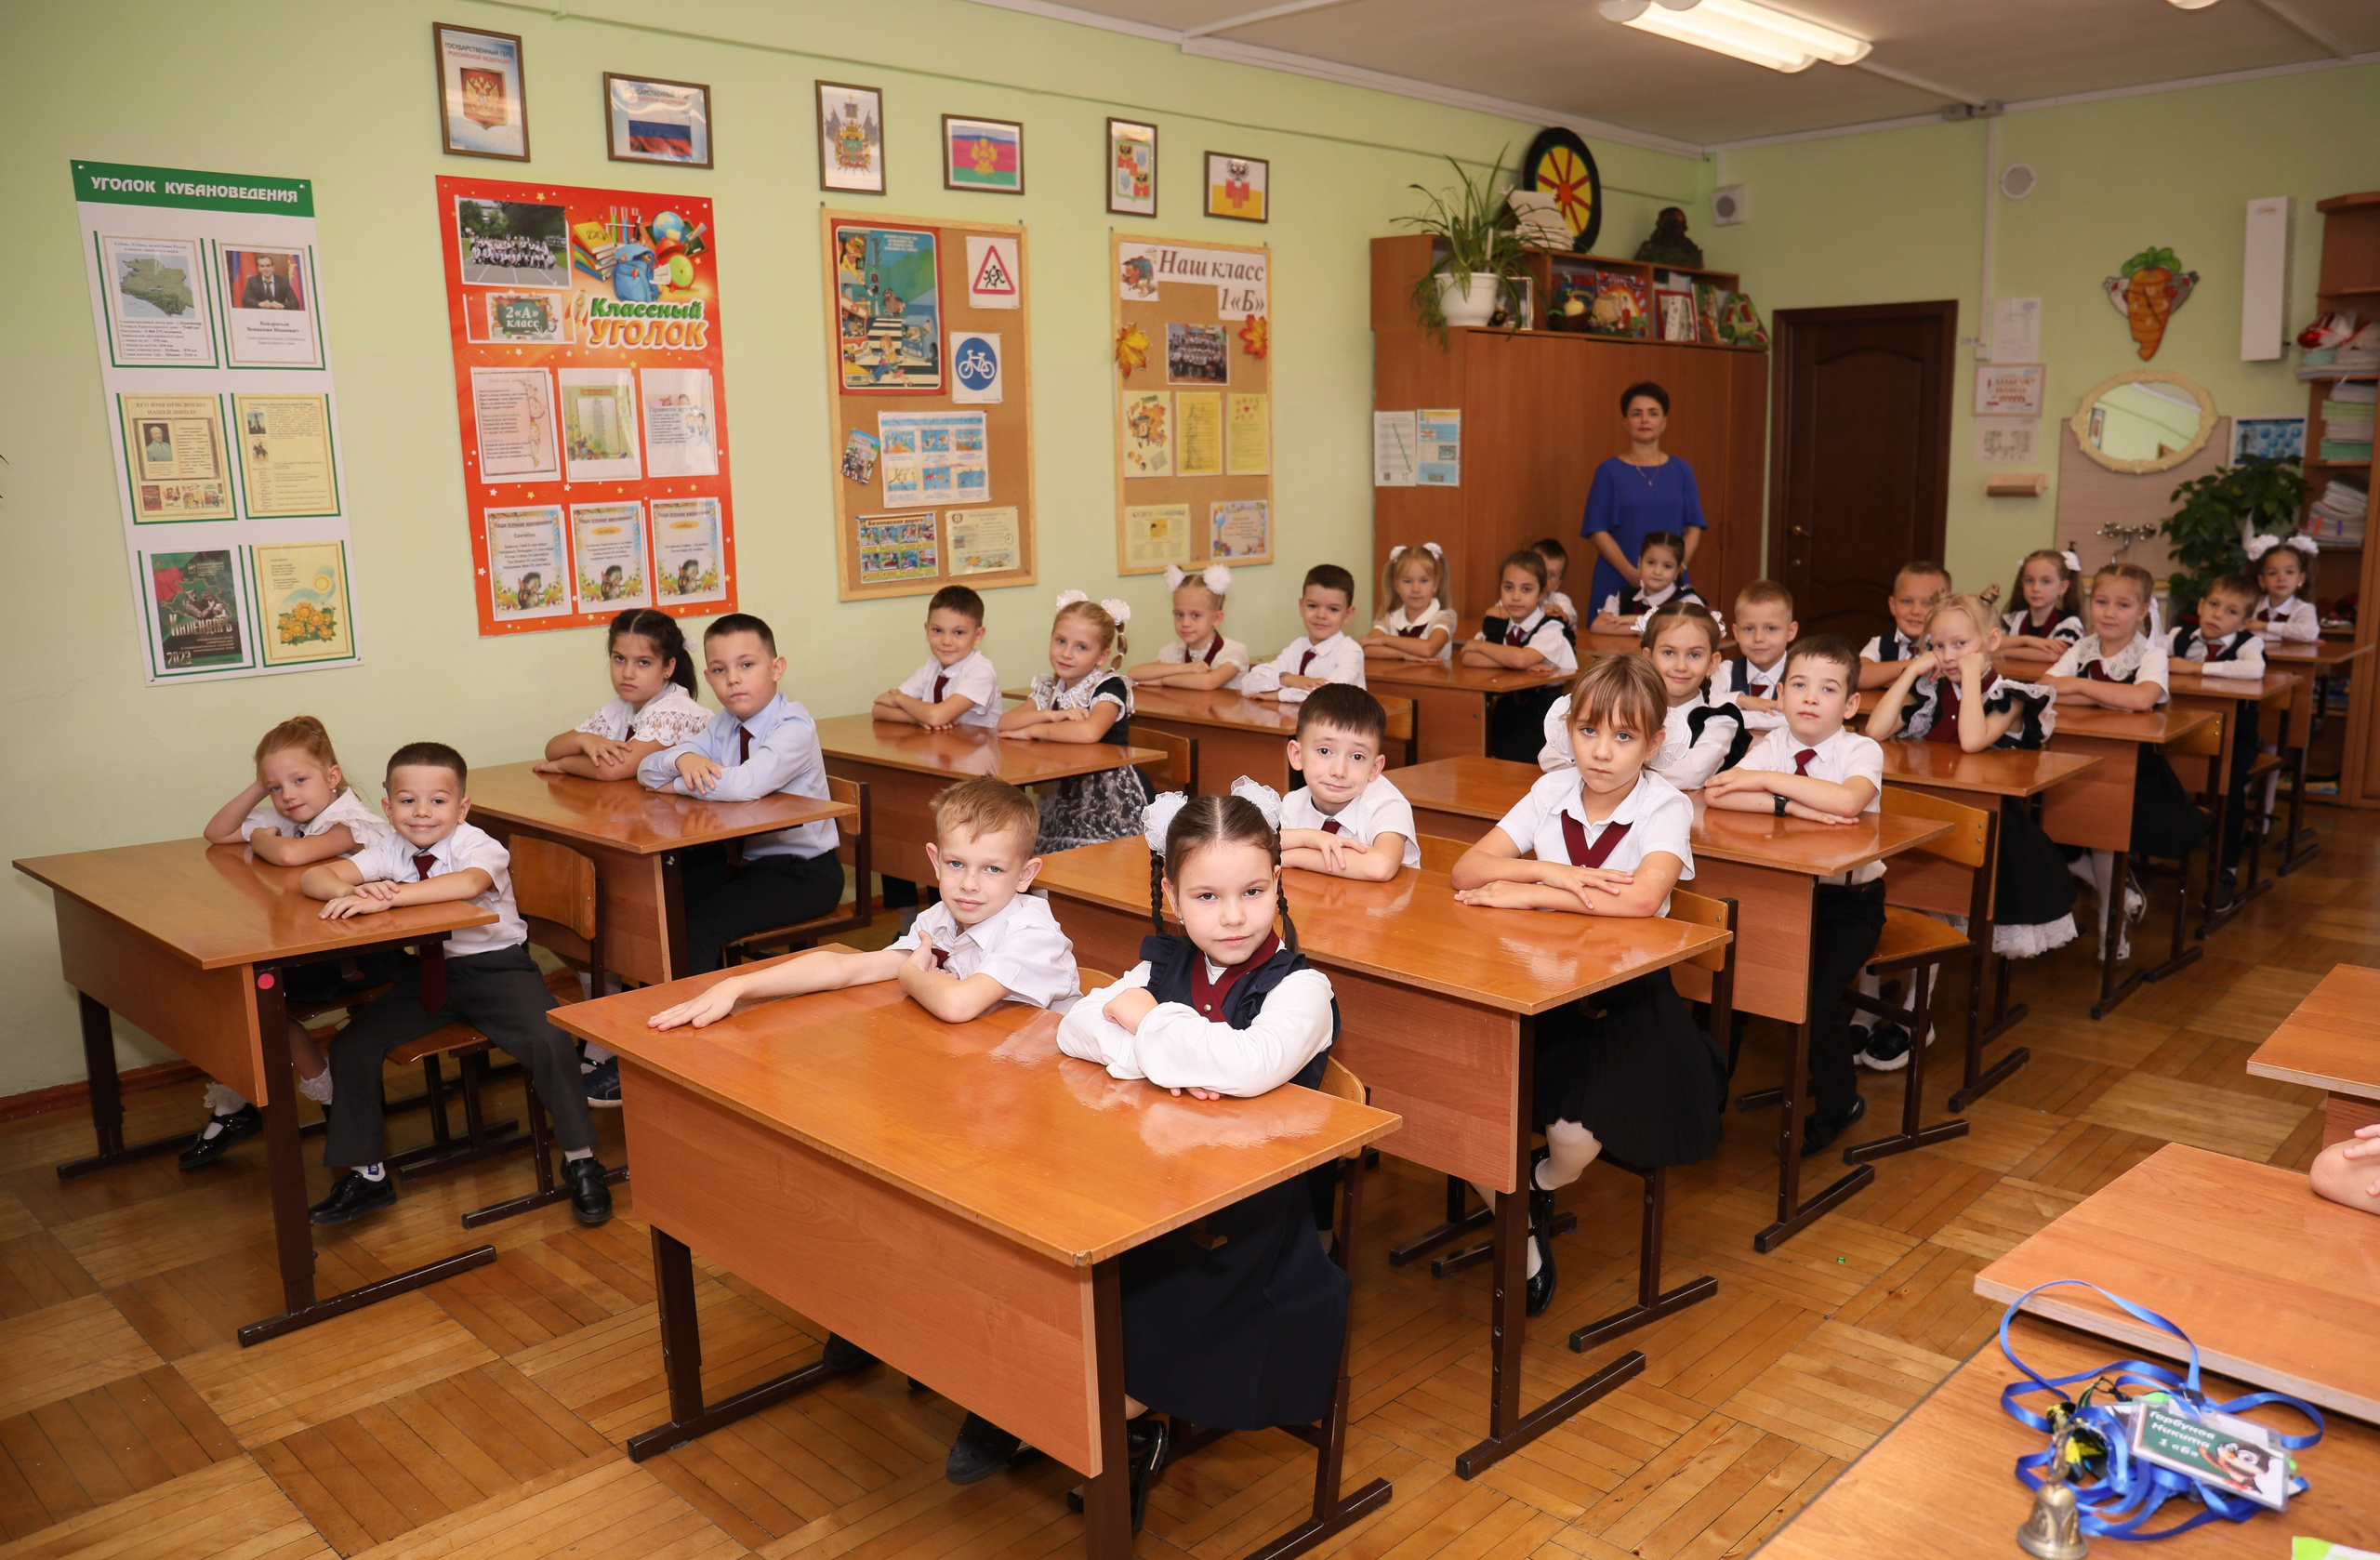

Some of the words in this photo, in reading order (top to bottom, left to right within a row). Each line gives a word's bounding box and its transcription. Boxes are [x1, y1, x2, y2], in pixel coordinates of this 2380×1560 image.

[90, 177, 157, 194] УГОЛОК
[165, 181, 298, 204] КУБАНОВЕДЕНИЯ
[1158, 250, 1208, 277] Наш
[1211, 261, 1264, 282] класс
[505, 306, 539, 320] 2«А»
[590, 297, 703, 320] Классный
[506, 319, 540, 330] класс
[589, 318, 707, 347] УГОЛОК
[165, 650, 193, 667] 2023
[2149, 1410, 2216, 1441] Горбунов
[2150, 1421, 2212, 1450] Никита
